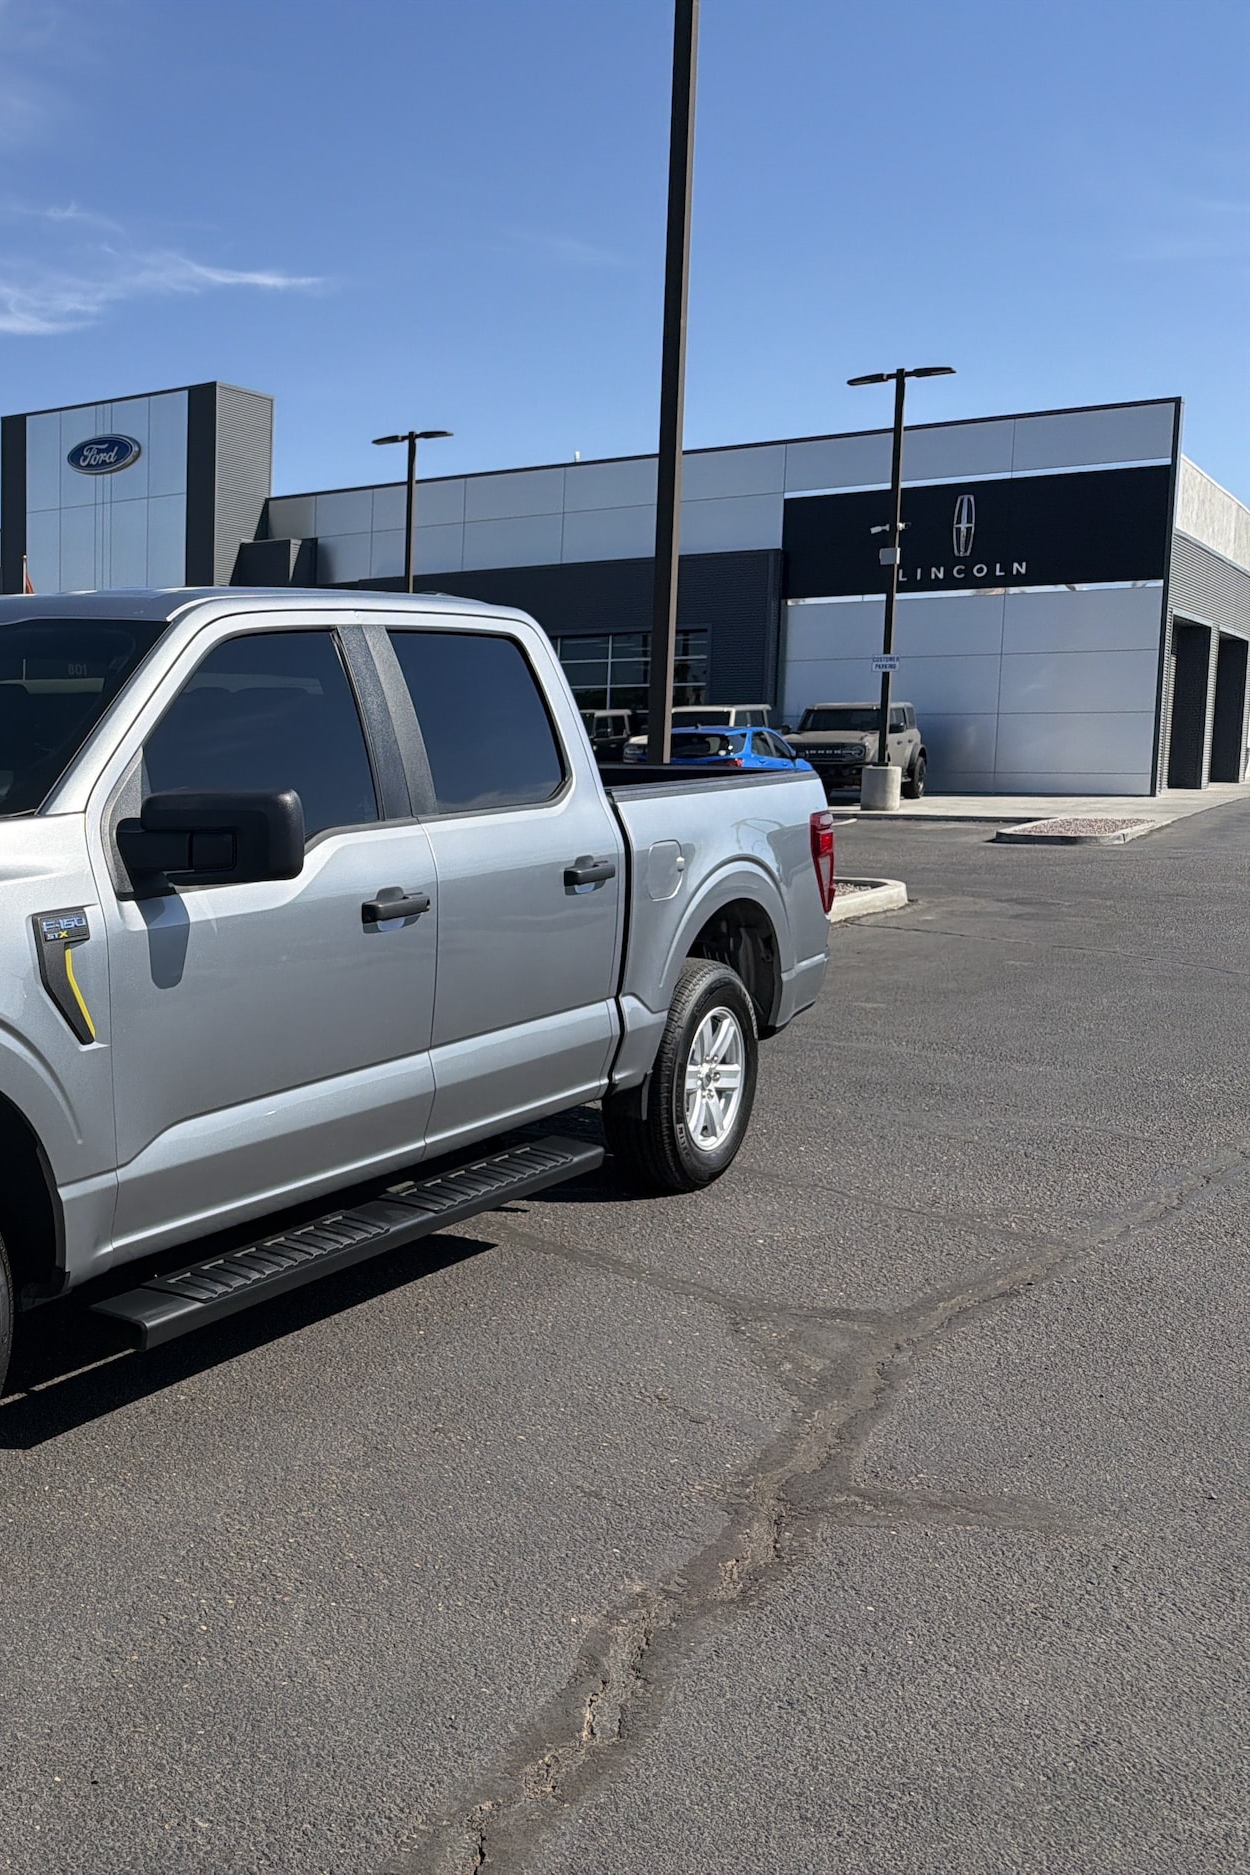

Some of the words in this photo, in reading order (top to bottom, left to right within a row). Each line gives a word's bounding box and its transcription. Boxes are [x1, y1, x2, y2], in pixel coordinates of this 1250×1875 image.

[80, 443, 118, 467] Ford
[898, 561, 1027, 582] LINCOLN
[43, 917, 86, 932] F-150
